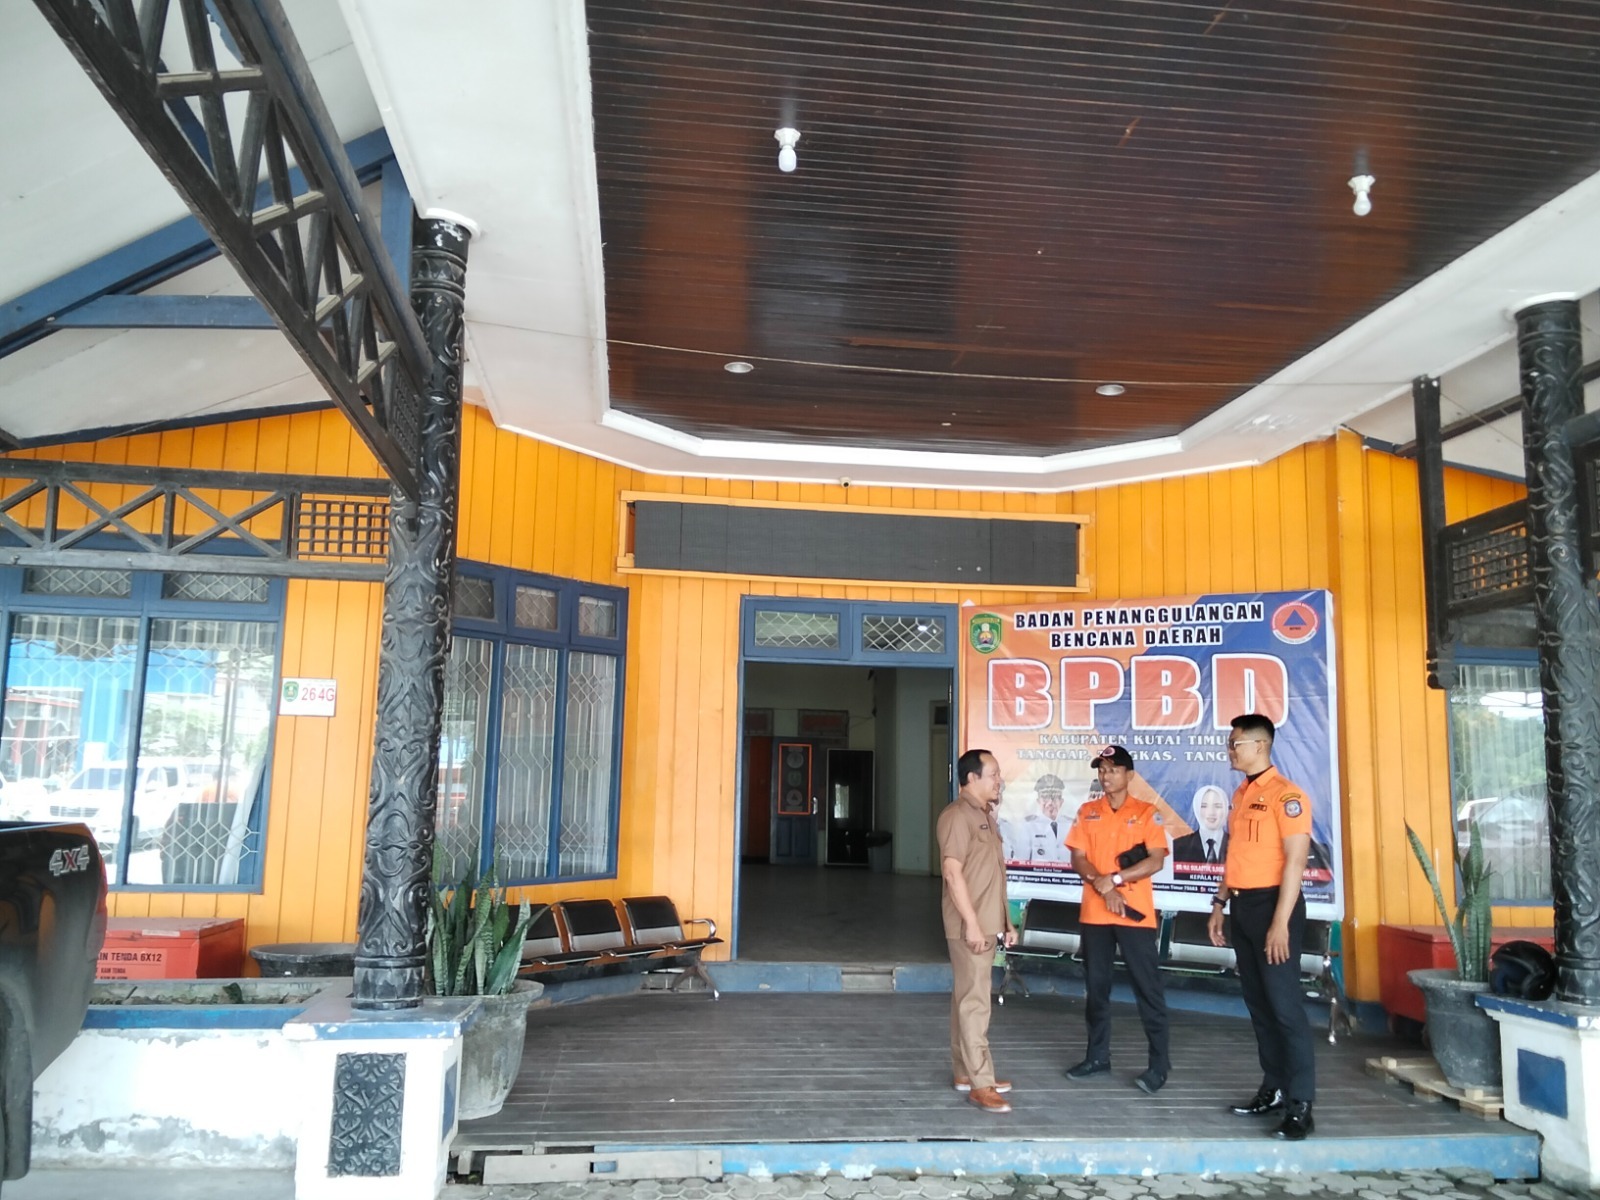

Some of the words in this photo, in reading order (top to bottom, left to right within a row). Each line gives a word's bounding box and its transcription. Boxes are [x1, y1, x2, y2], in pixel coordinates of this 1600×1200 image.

[1015, 611, 1074, 628] BADAN
[1083, 603, 1262, 626] PENANGGULANGAN
[1051, 631, 1135, 648] BENCANA
[1145, 627, 1221, 645] DAERAH
[988, 654, 1289, 731] BPBD
[1039, 734, 1128, 745] KABUPATEN
[1133, 735, 1181, 746] KUTAI
[1187, 735, 1230, 746] TIMU
[1183, 751, 1228, 762] TANG
[49, 844, 90, 877] 4X4
[99, 952, 109, 961] IN
[111, 952, 138, 961] TENDA
[140, 953, 162, 962] 6X12
